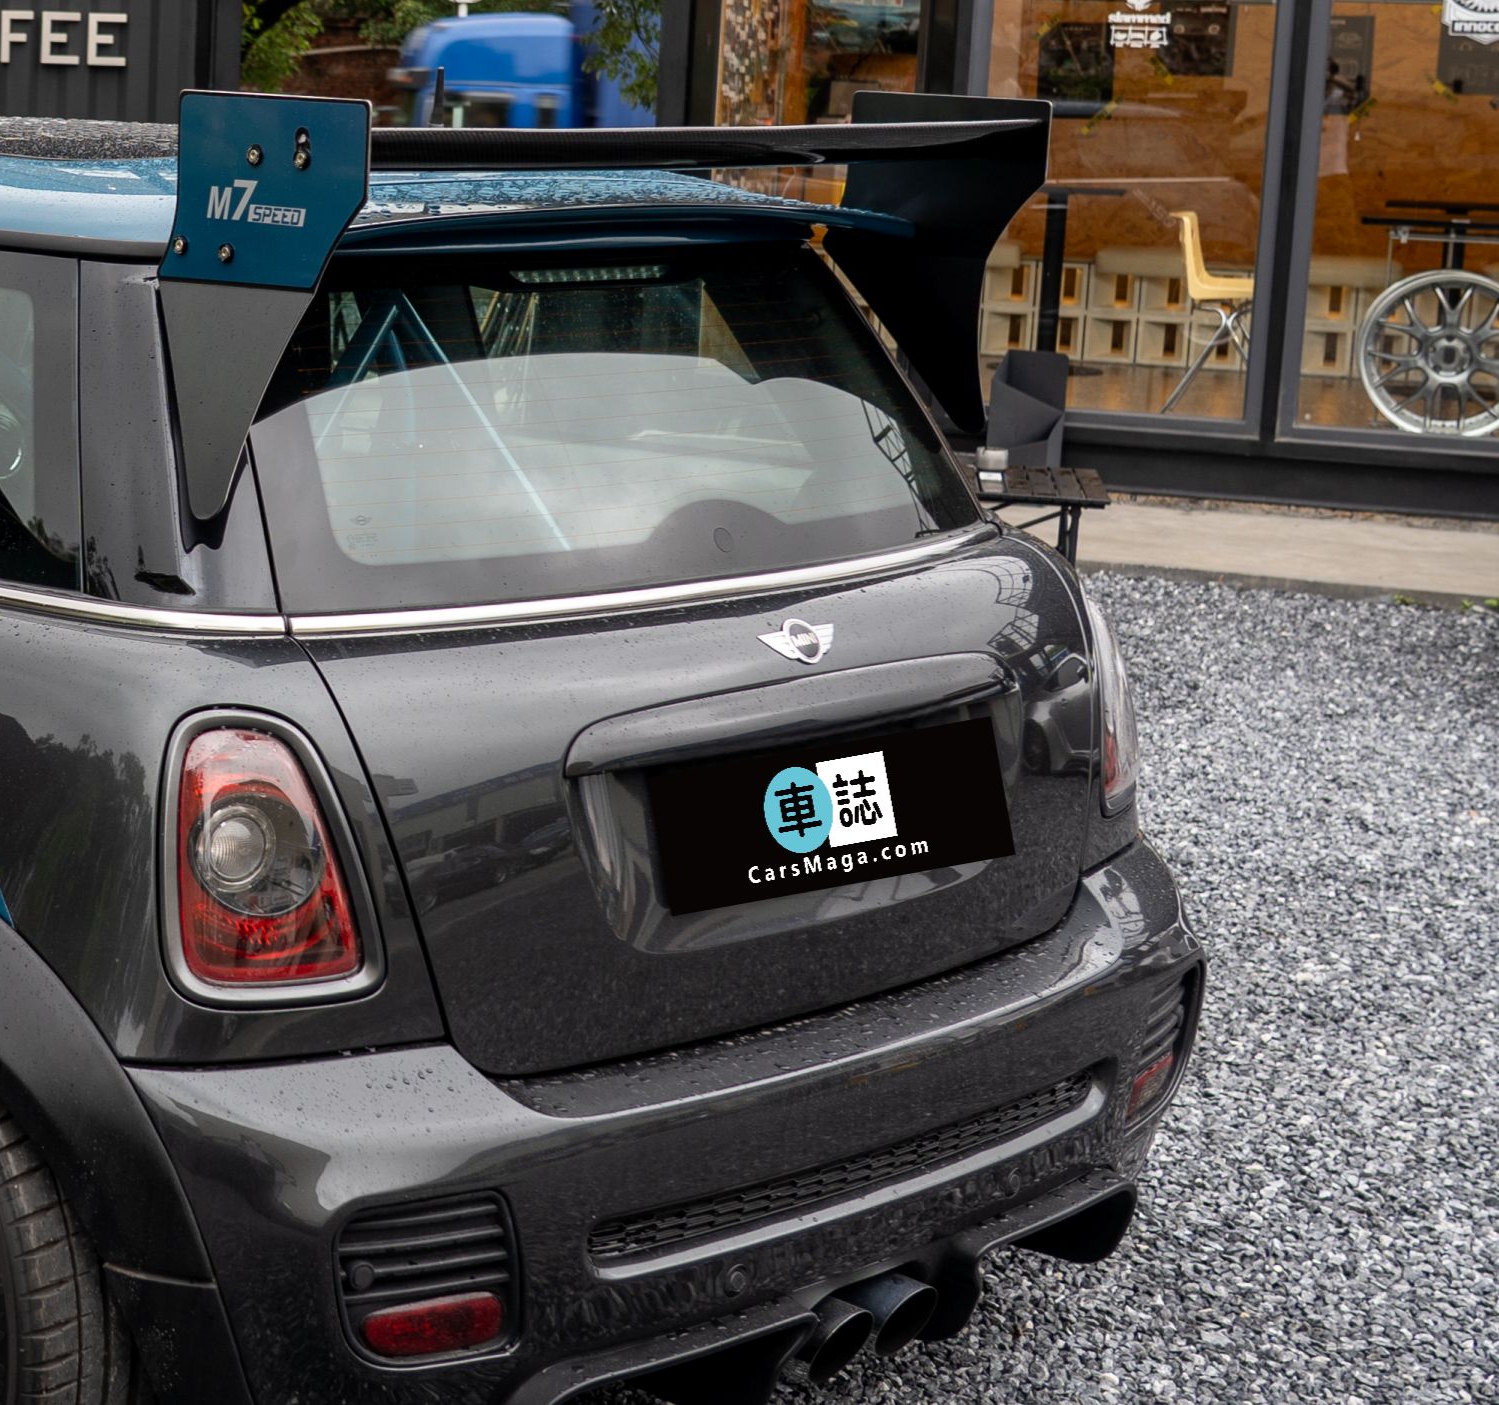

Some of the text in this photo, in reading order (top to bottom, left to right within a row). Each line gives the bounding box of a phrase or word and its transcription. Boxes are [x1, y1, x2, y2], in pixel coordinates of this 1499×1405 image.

[206, 179, 303, 226] M7 SPEED
[790, 632, 819, 648] MINI
